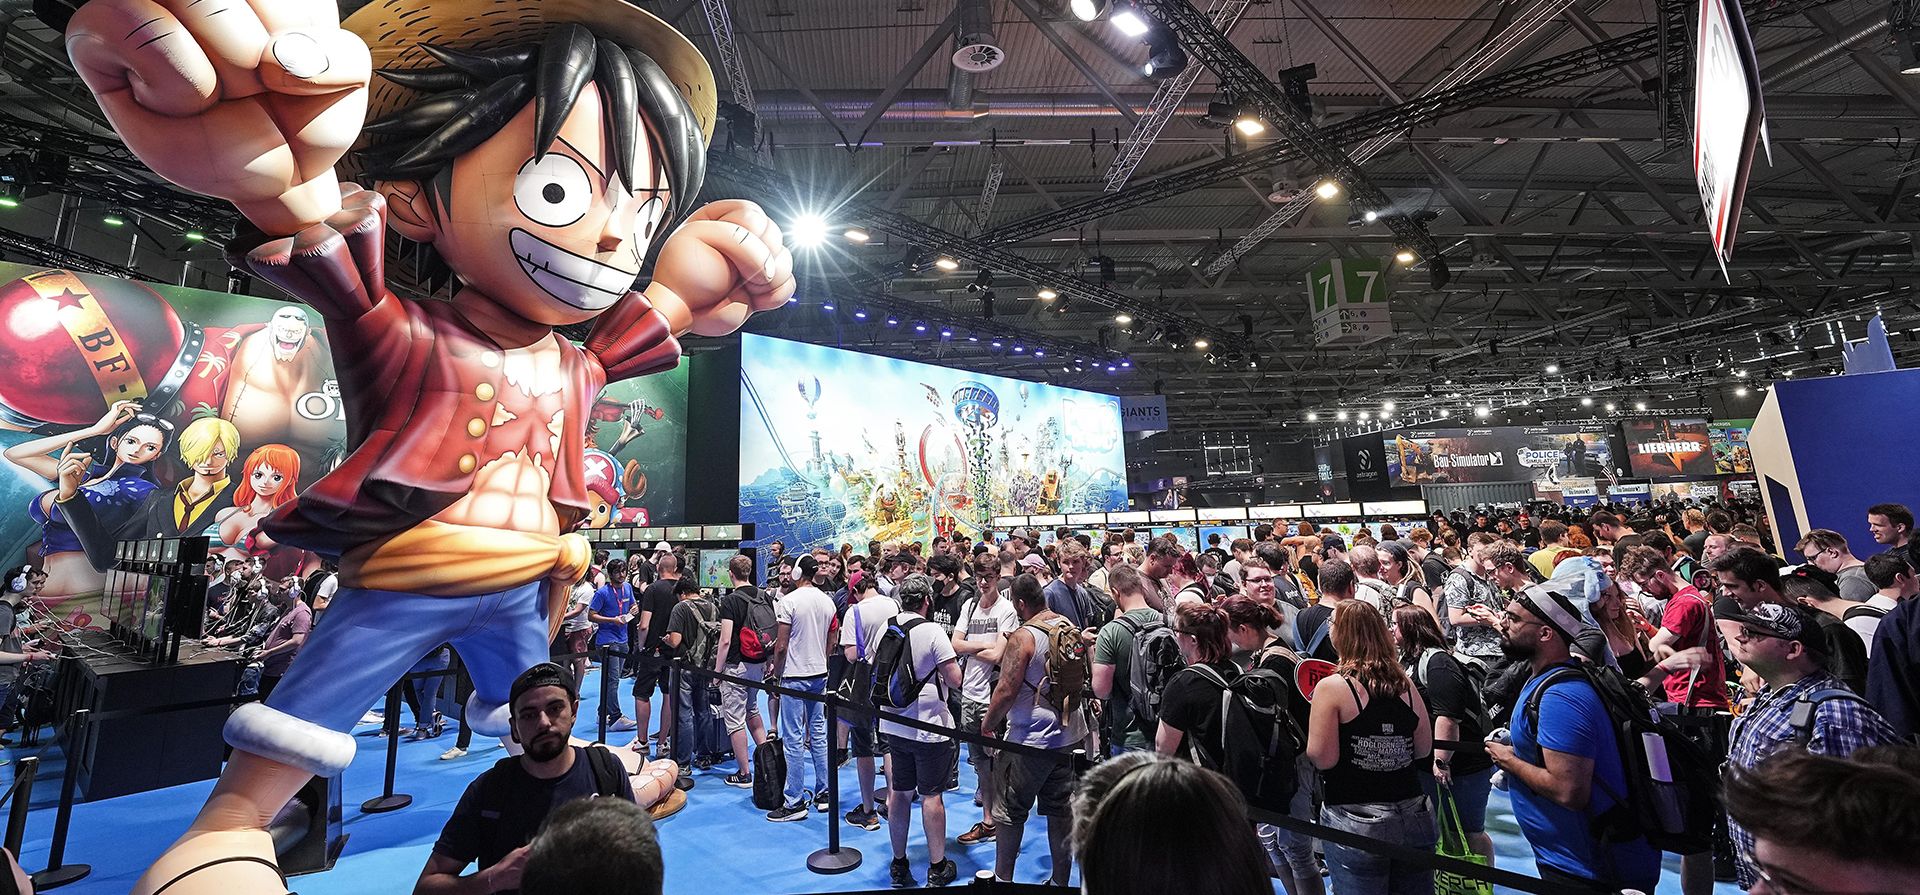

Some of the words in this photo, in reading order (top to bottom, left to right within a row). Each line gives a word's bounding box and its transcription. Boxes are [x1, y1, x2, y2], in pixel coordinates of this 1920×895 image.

[1318, 273, 1332, 310] 7
[1356, 271, 1379, 304] 7
[1121, 406, 1160, 417] GIANTS
[1638, 441, 1702, 454] LIEBHERR
[1433, 452, 1489, 468] Bau-Simulator
